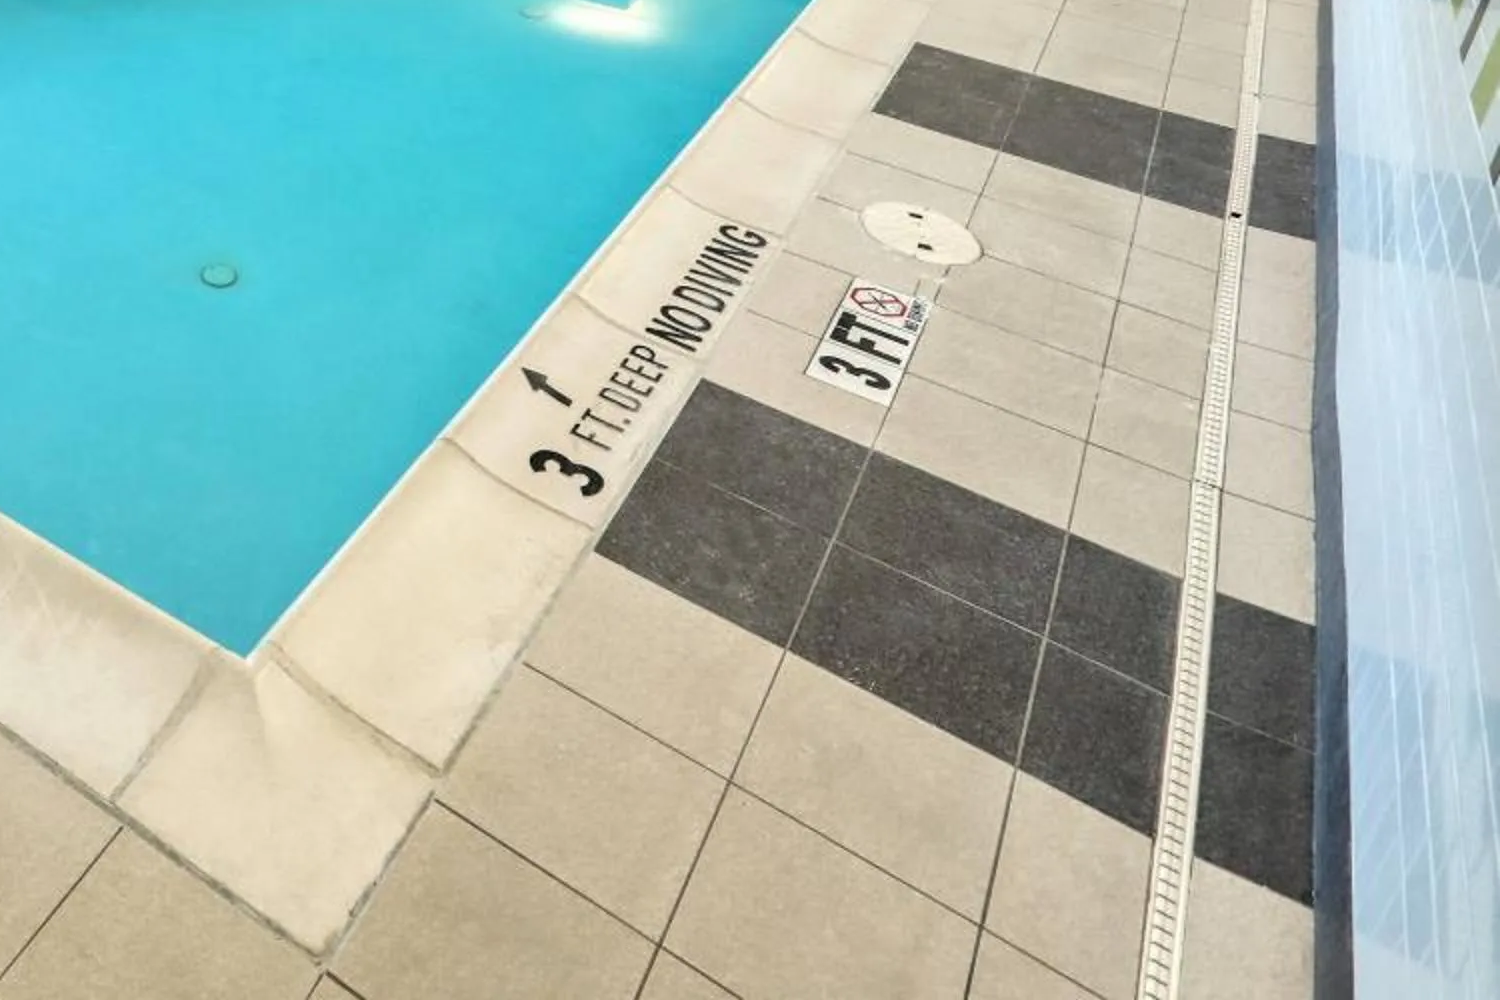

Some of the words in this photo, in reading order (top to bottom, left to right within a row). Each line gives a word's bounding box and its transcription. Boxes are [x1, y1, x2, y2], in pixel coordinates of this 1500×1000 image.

[672, 225, 767, 313] DIVING
[645, 305, 712, 352] NO
[830, 312, 909, 365] FT
[599, 345, 668, 412] DEEP
[819, 356, 891, 390] 3
[570, 408, 631, 451] FT.
[529, 449, 604, 496] 3
